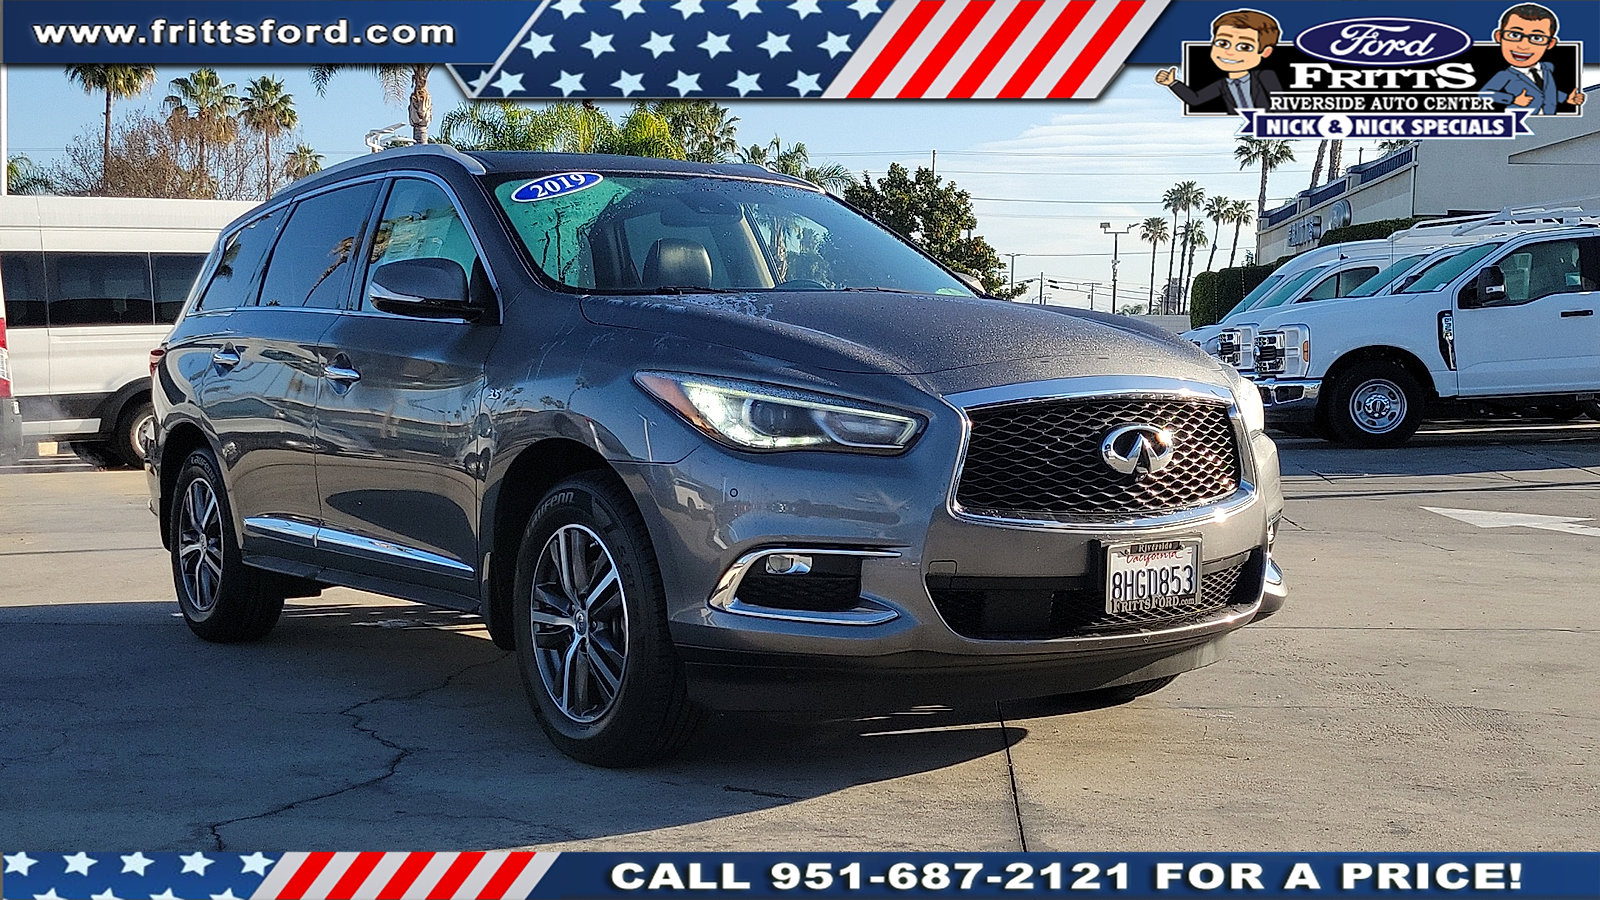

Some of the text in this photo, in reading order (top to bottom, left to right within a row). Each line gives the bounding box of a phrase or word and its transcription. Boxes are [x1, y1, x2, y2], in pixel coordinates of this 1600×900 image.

[530, 173, 587, 198] 2019
[1126, 551, 1184, 566] California
[1112, 564, 1194, 601] 8HGD853
